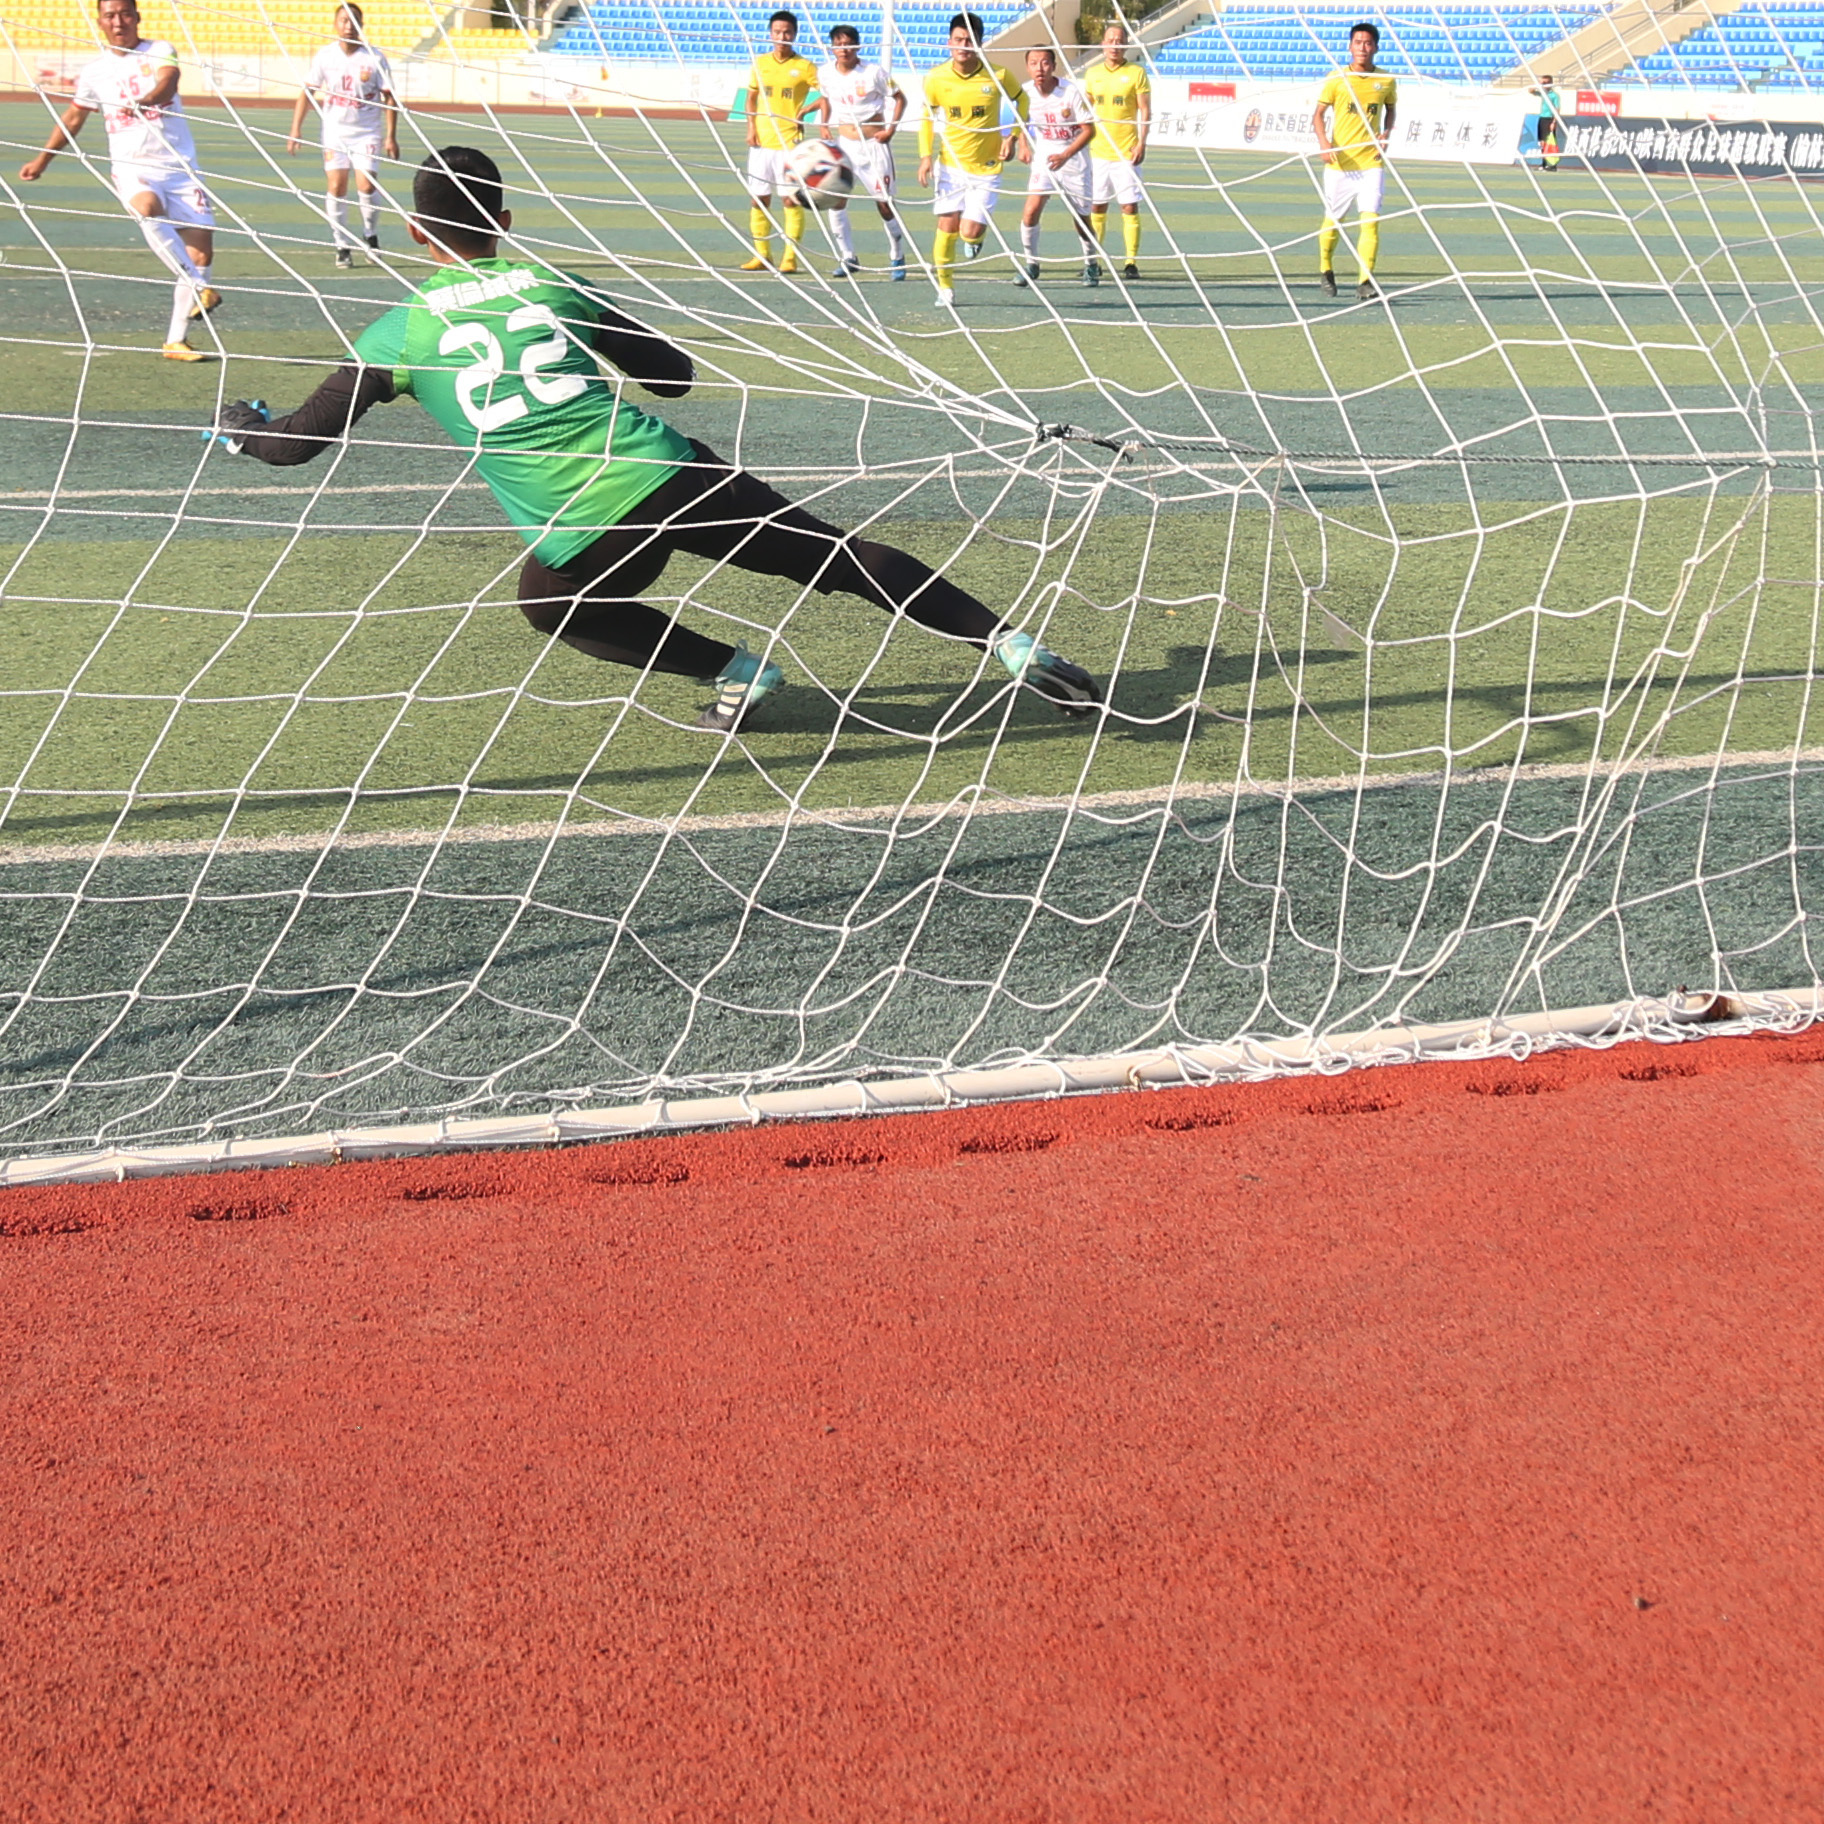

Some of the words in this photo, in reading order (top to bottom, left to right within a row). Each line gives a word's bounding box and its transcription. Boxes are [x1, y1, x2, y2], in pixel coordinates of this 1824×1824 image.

[341, 75, 354, 92] 12
[1156, 111, 1209, 138] 西体彩
[1406, 119, 1499, 149] 陕西体彩
[438, 304, 589, 433] 22
